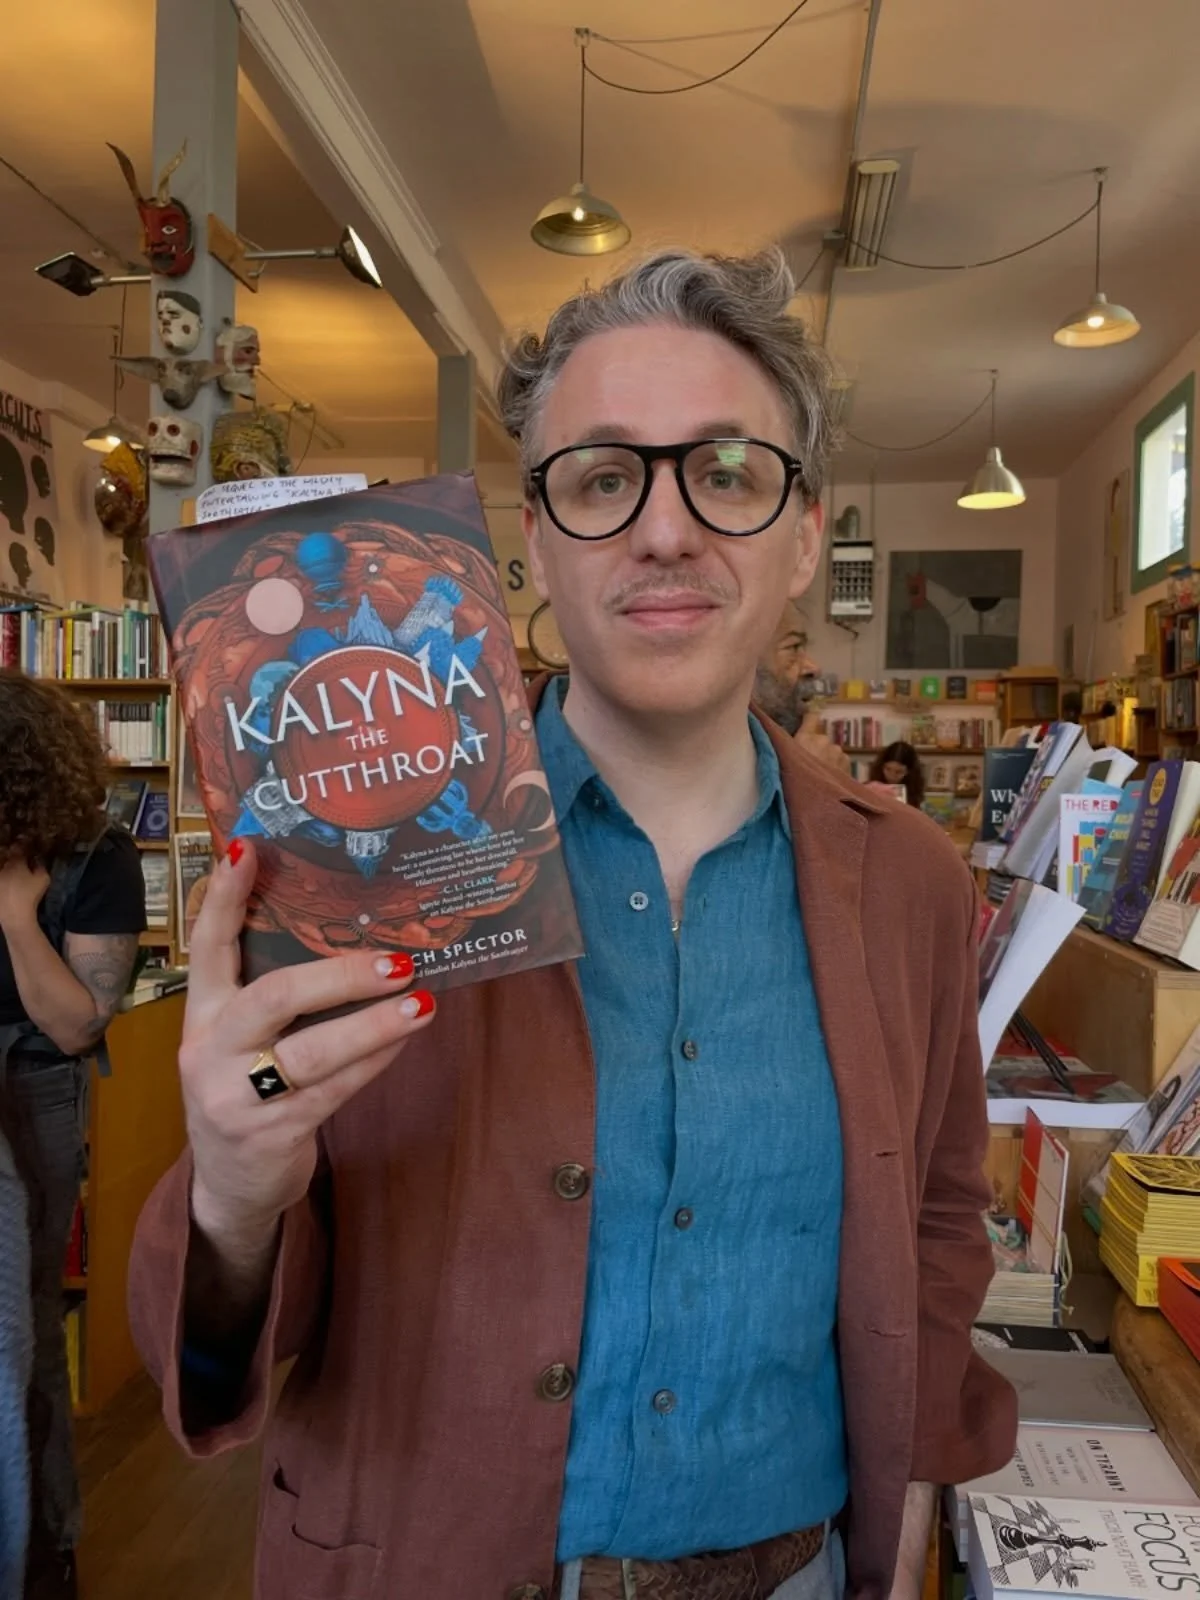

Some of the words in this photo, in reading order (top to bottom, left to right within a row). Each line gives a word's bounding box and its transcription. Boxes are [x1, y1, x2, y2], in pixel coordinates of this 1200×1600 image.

[0, 391, 42, 438] CUTS
[221, 480, 255, 493] SEQUEL
[262, 480, 275, 488] TO
[279, 478, 296, 488] THE
[226, 641, 486, 751] KALYNA
[345, 726, 389, 751] THE
[254, 733, 488, 811] CUTTHROAT
[1065, 799, 1088, 811] THE
[443, 928, 527, 960] SPECTOR
[1086, 1439, 1104, 1451] ON
[1094, 1453, 1128, 1493] TYRANNY
[1123, 1510, 1200, 1593] FOCUS
